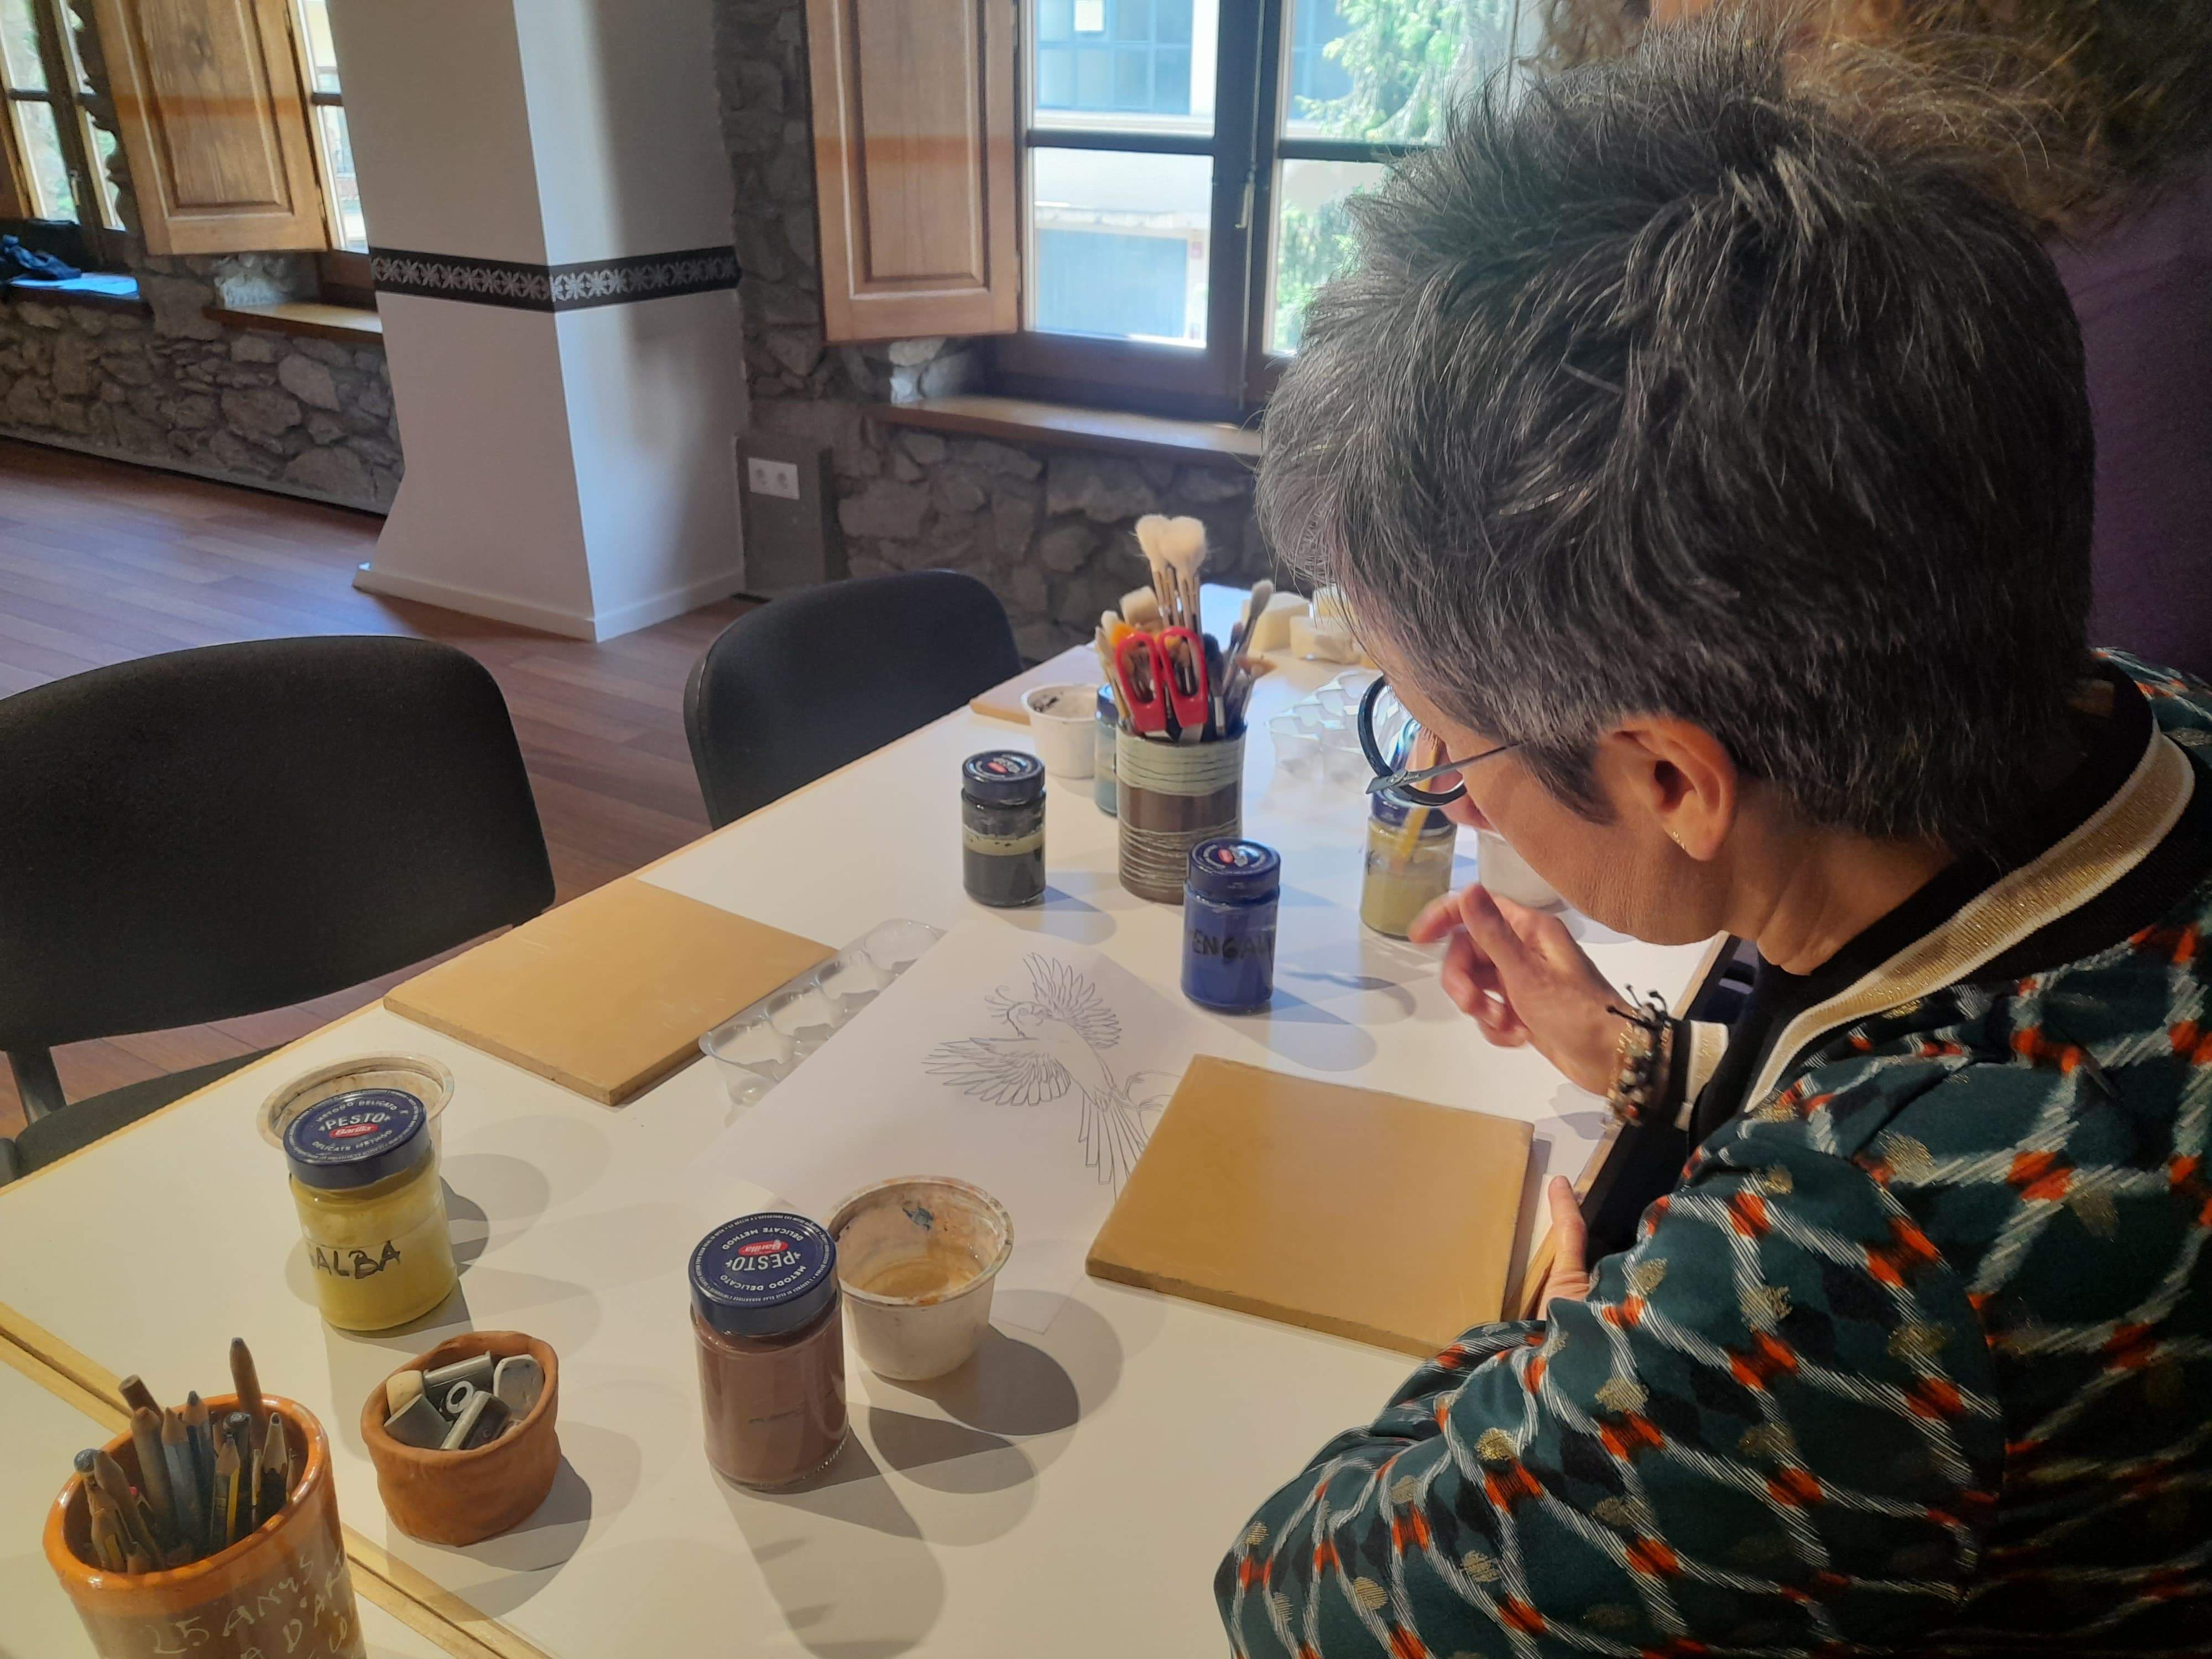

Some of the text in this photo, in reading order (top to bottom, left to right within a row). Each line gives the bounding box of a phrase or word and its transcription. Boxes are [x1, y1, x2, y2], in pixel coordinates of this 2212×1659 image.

[314, 1102, 354, 1123] METODO
[358, 1099, 398, 1112] DELICATO
[326, 1112, 386, 1130] PESTO
[311, 1140, 352, 1152] DELICATE
[355, 1129, 393, 1150] METHOD
[335, 1125, 372, 1136] Barilla
[721, 1228, 759, 1251] METHOD
[762, 1227, 805, 1242] DELICATE
[744, 1240, 782, 1253] Barilla
[731, 1250, 797, 1271] PESTO
[719, 1265, 807, 1291] METODO DELICATO
[144, 1615, 210, 1655] 25
